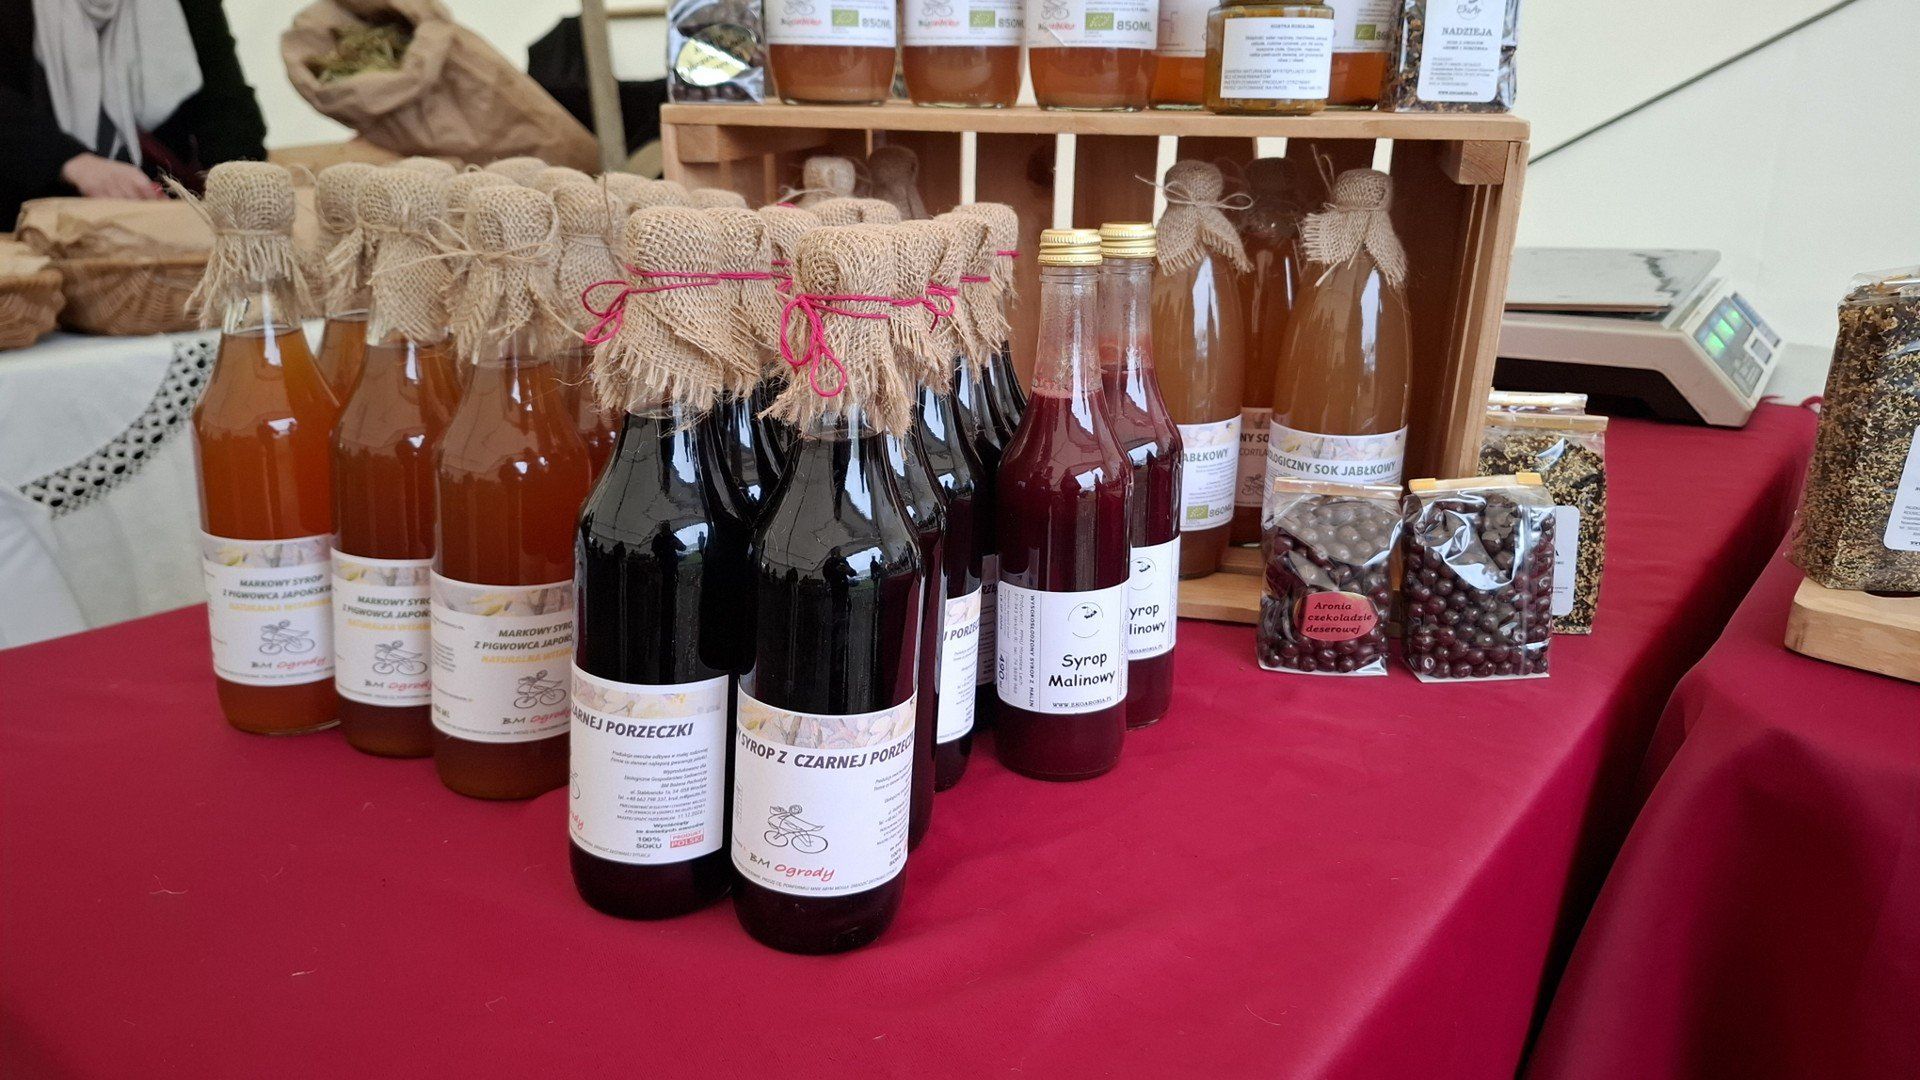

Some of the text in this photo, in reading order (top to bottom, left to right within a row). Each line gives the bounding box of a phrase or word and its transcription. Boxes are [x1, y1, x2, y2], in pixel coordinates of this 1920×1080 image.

[1116, 20, 1152, 32] 850ML
[1441, 27, 1492, 36] NADZIEJA
[1313, 463, 1339, 477] SOK
[1340, 460, 1397, 478] JABŁKOWY
[240, 574, 324, 587] MARKOWY SYROP
[228, 590, 279, 600] PIGWOWCA
[358, 595, 407, 606] MARKOWY
[1129, 604, 1159, 620] yrop
[1313, 602, 1352, 610] Aronia
[1307, 612, 1372, 623] czekoladzie
[498, 626, 552, 638] MARKOWY
[1129, 620, 1167, 635] linowy
[1305, 625, 1361, 635] deserowej
[474, 640, 480, 649] Z
[482, 641, 539, 651] PIGWOWCA
[276, 657, 326, 670] Ogrody
[1061, 653, 1107, 670] Syrop
[1048, 670, 1116, 687] Malinowy
[502, 716, 526, 725] BM
[605, 720, 695, 739] PORZECZKI
[741, 733, 775, 760] SYROP
[777, 750, 788, 764] Z
[794, 754, 867, 769] CZARNEJ
[774, 864, 835, 882] Ogrody
